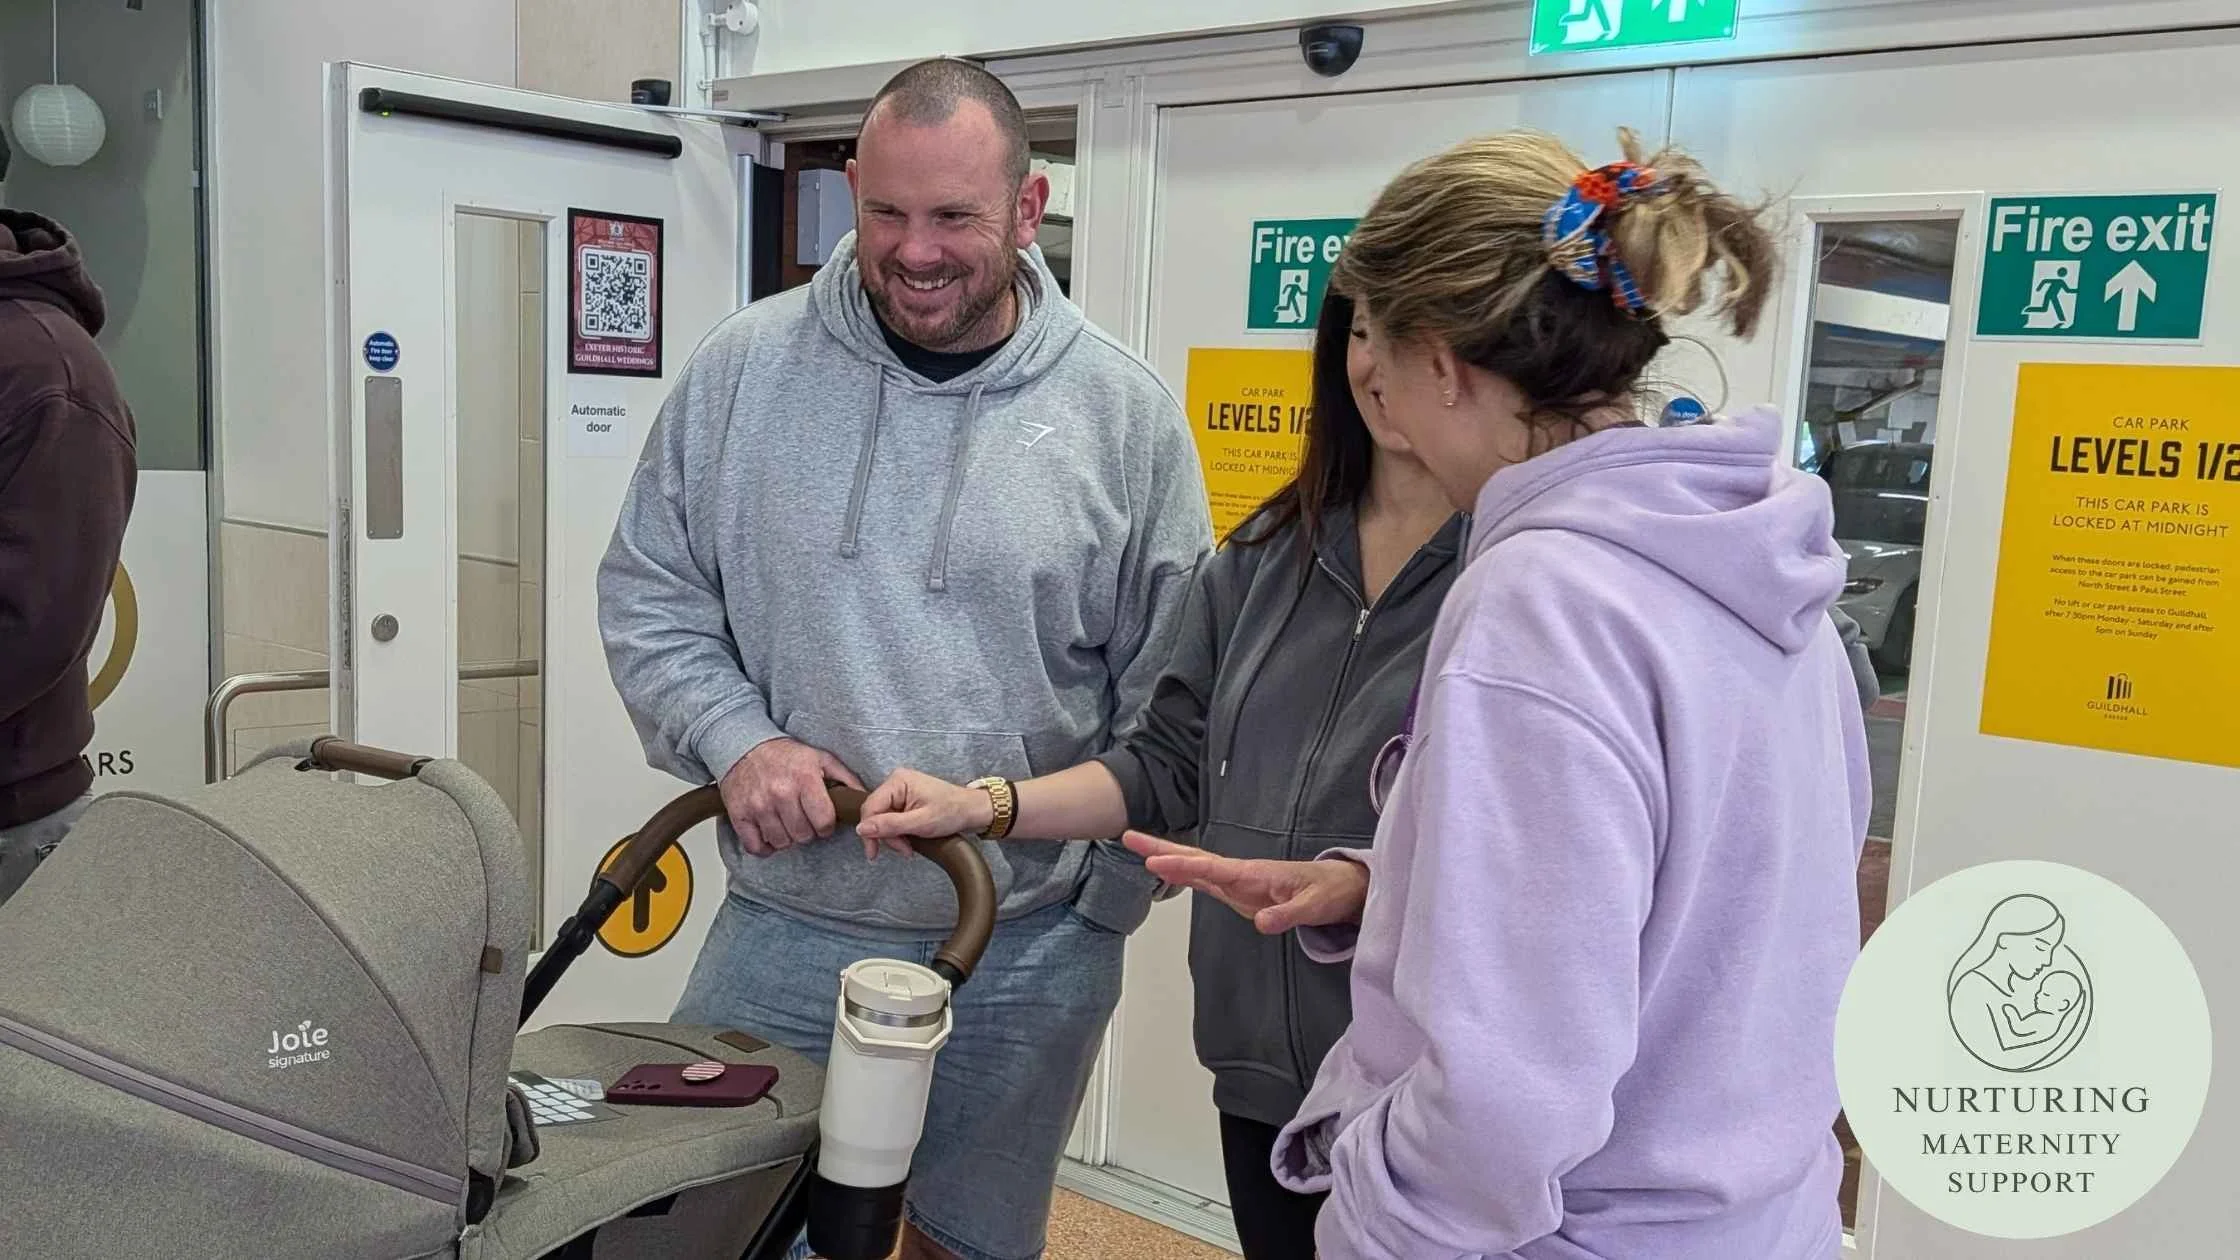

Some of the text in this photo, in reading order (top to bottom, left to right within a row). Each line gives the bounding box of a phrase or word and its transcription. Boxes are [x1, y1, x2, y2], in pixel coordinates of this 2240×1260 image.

[1992, 202, 2211, 253] Fire exit
[1255, 227, 1315, 263] Fire
[585, 343, 646, 354] EXETER HISTORIC
[575, 353, 653, 365] GUILDHALL WEDDINGS
[1241, 387, 1285, 398] CAR PARK
[571, 404, 626, 416] Automatic
[1208, 402, 1281, 433] LEVELS
[586, 421, 612, 432] door
[2112, 416, 2190, 431] CAR PARK
[1223, 448, 1241, 458] THIS
[1244, 448, 1261, 459] CAR
[1265, 450, 1287, 460] PARK
[2050, 435, 2240, 482] LEVELS 1/2
[1210, 461, 1297, 476] LOCKED AT MIDNIG
[2076, 496, 2209, 516] THIS CAR PARK IS
[2053, 515, 2229, 538] LOCKED AT MIDNIGHT
[2052, 554, 2076, 563] When
[2077, 556, 2100, 565] these
[2101, 558, 2126, 567] doors
[2089, 569, 2103, 577] the
[2155, 574, 2166, 582] be
[2079, 580, 2104, 589] North
[2104, 583, 2130, 592] Street
[2096, 614, 2129, 624] Monday
[2137, 618, 2173, 629] Saturday
[2087, 701, 2148, 715] GUILDHALL
[268, 1020, 328, 1053] Joie
[268, 1049, 330, 1069] signature
